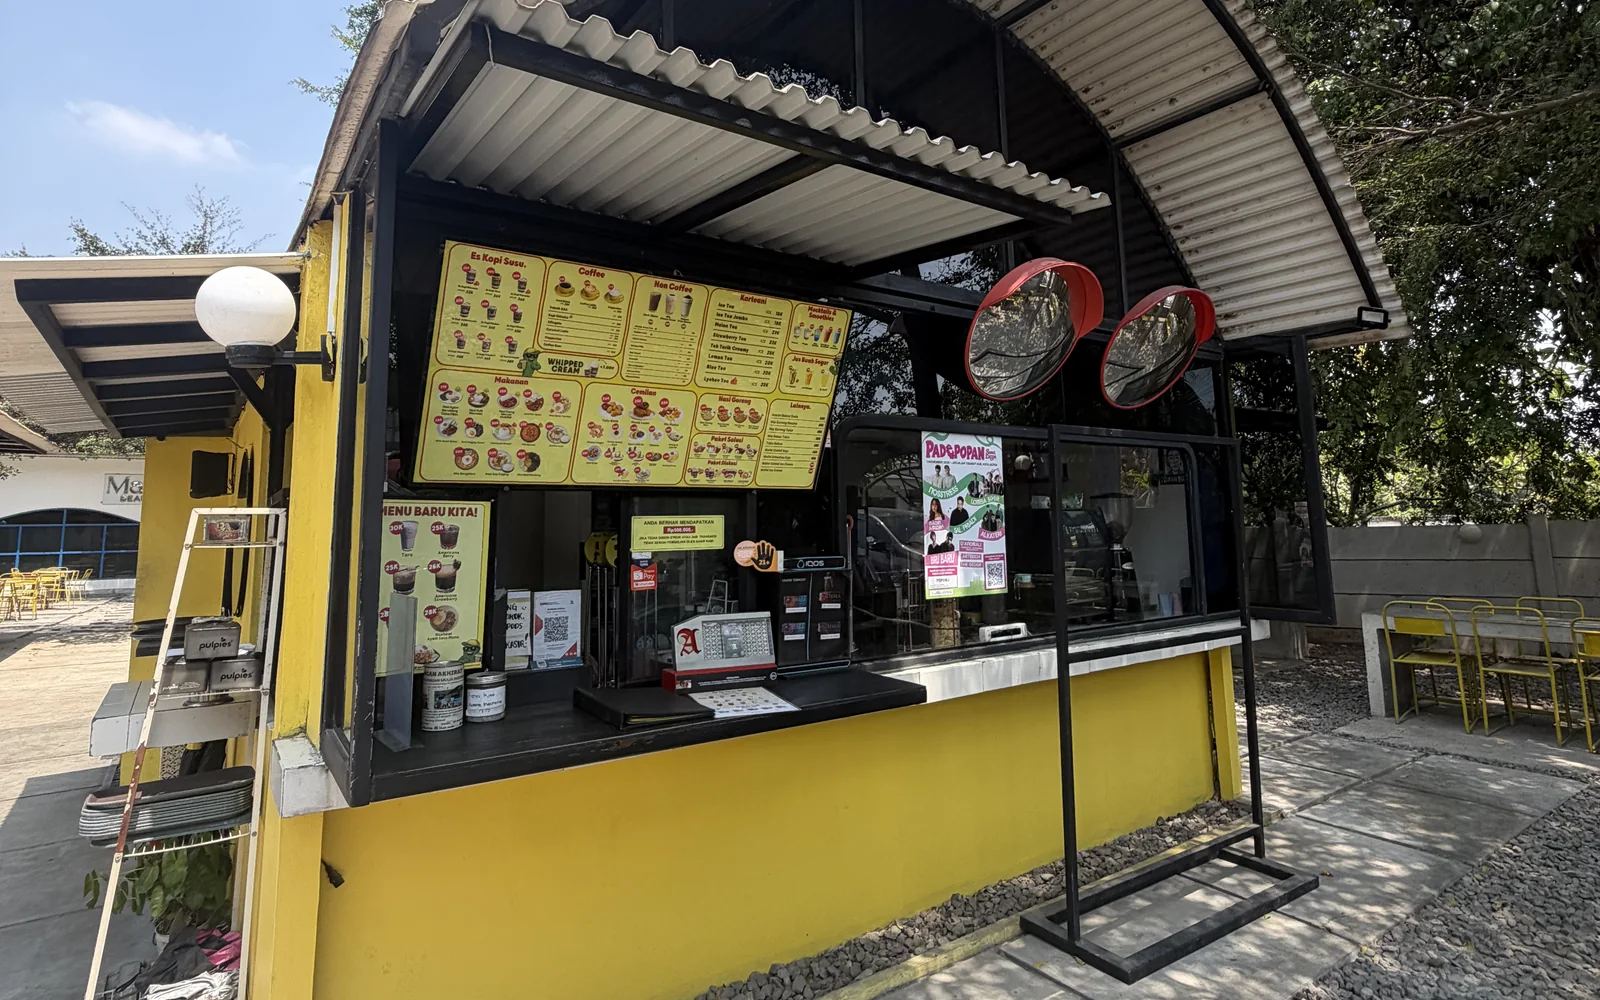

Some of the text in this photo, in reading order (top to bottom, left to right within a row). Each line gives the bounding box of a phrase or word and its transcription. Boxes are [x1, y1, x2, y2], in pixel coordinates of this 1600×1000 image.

[471, 252, 526, 268] Es Kopi Susu.
[578, 267, 605, 278] Coffee
[654, 280, 693, 293] Non Coffee
[548, 358, 584, 368] WHIPPED
[551, 366, 580, 374] CREAM
[495, 376, 528, 385] Makanan
[631, 388, 656, 396] Cemilan
[928, 485, 959, 498] NOSSTRESS
[414, 507, 446, 517] BARU
[448, 507, 478, 517] KITA!
[199, 641, 231, 651] pulpies
[220, 671, 252, 681] pulpies
